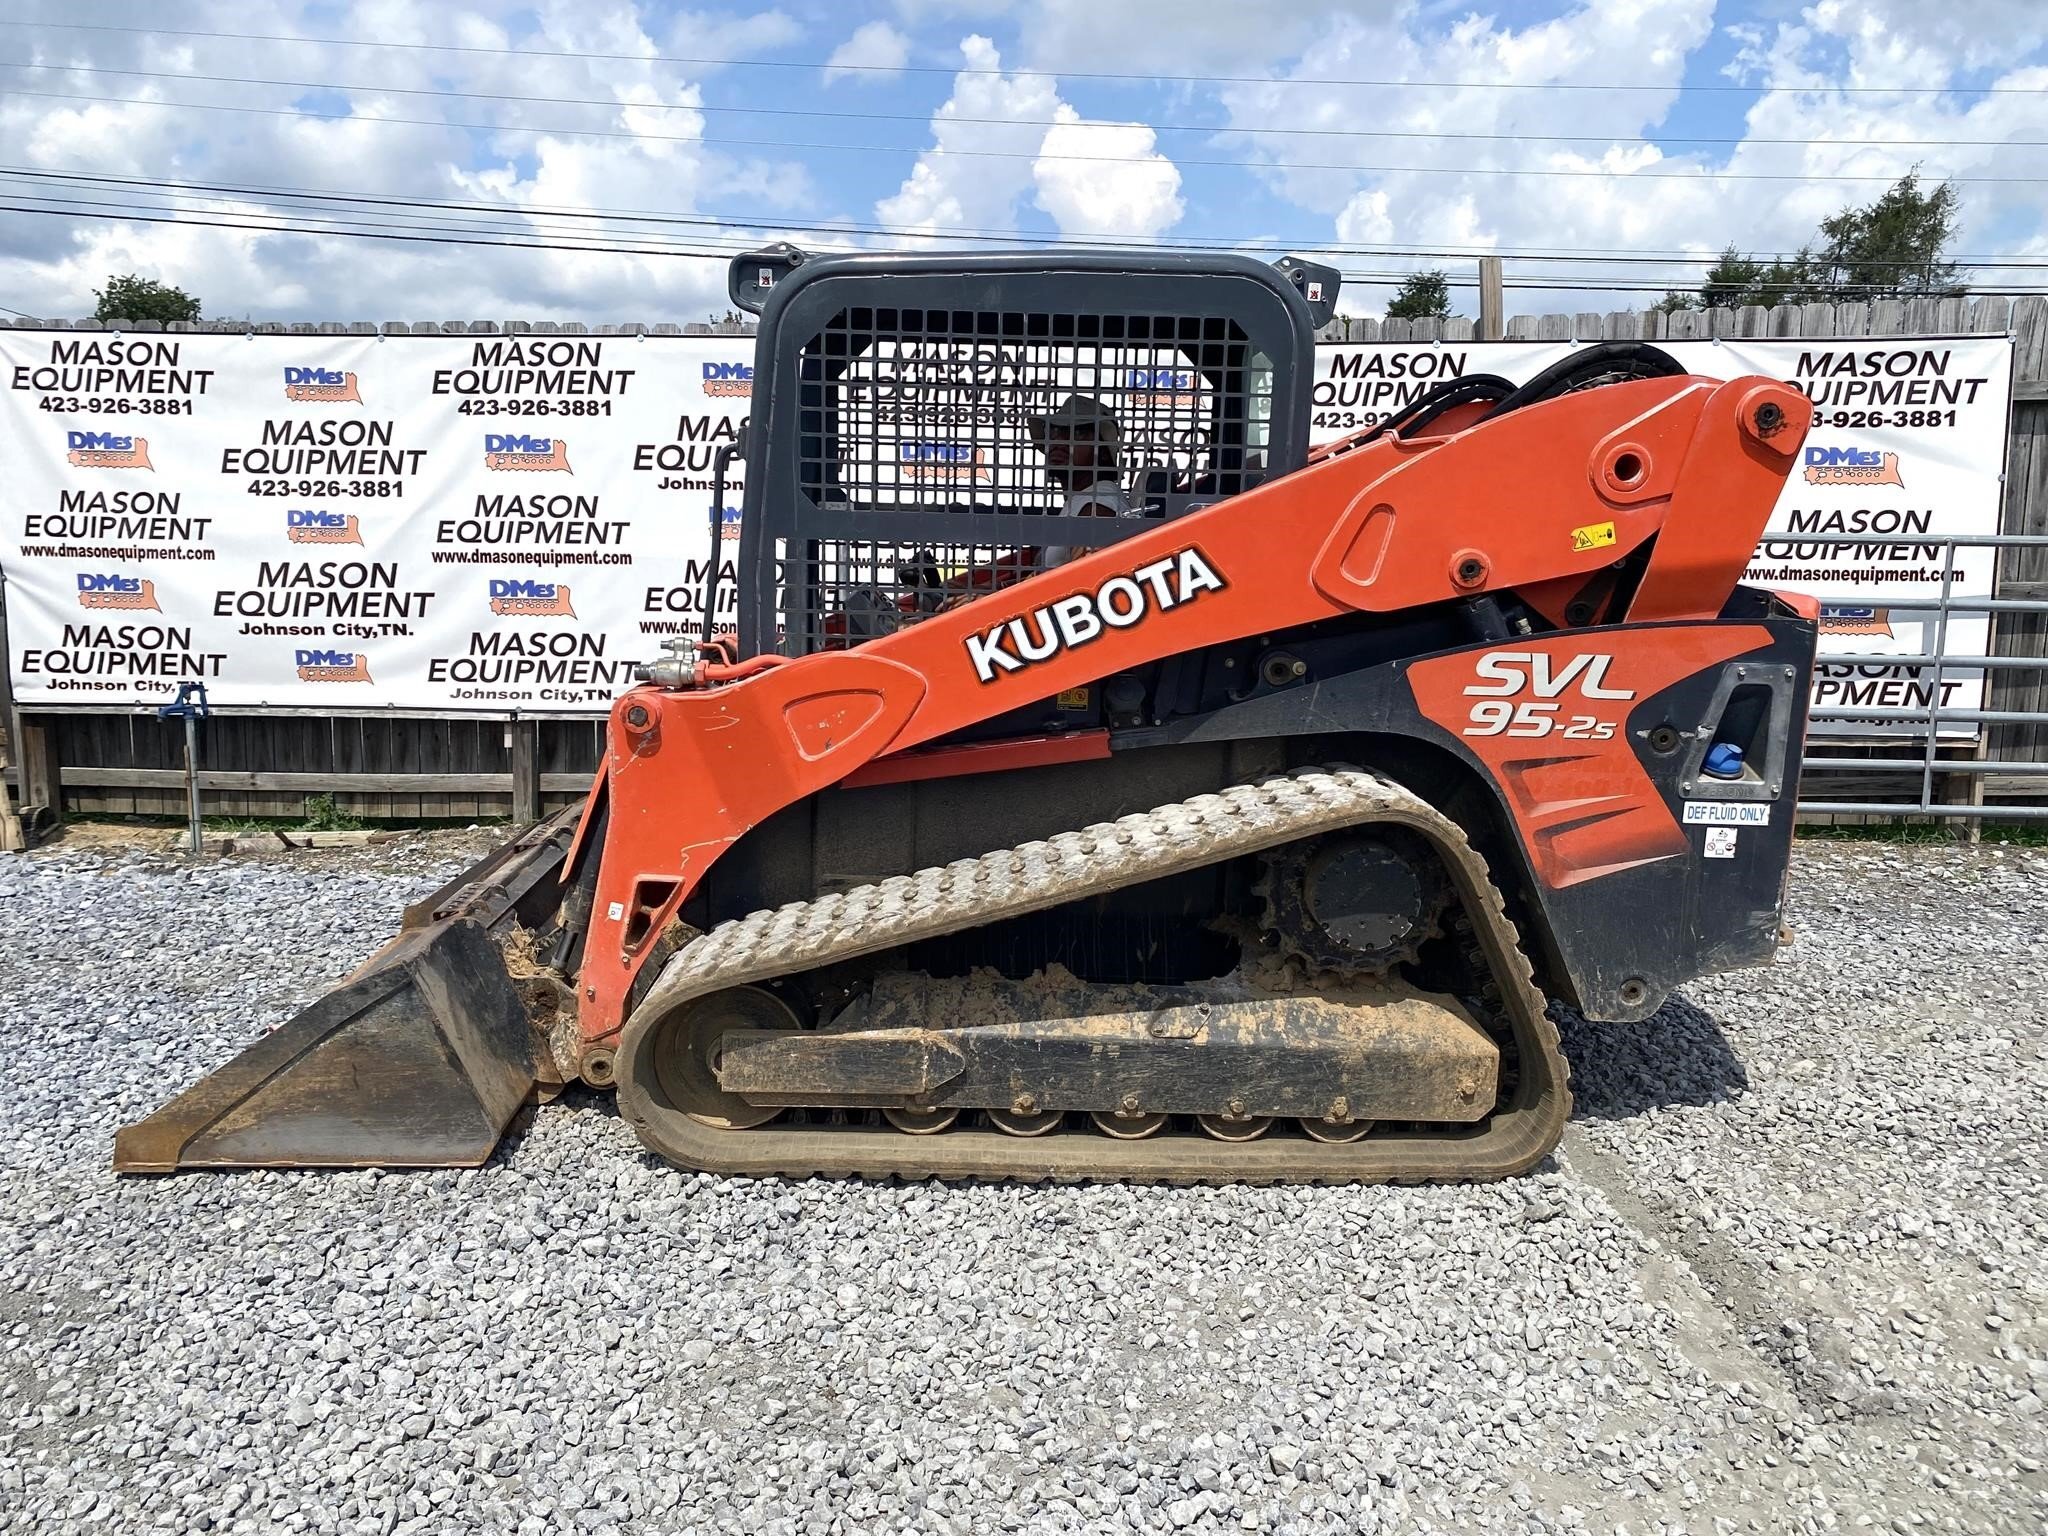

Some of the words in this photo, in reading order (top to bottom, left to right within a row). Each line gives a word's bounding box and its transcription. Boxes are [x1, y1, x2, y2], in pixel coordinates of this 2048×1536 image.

[52, 341, 179, 366] MASON
[473, 342, 601, 367] MASON
[1330, 353, 1467, 378] MASON
[1796, 351, 1951, 377] MASON
[12, 366, 214, 394] EQUIPMENT
[432, 370, 635, 394] EQUIPMENT
[40, 397, 191, 415] 423-926-3881
[458, 400, 610, 416] 423-926-3881
[262, 421, 393, 446] MASON
[222, 449, 427, 475] EQUIPMENT
[248, 480, 402, 497] 423-926-3881
[60, 490, 180, 514] MASON
[475, 495, 598, 518] MASON
[25, 515, 211, 540] EQUIPMENT
[437, 521, 630, 544] EQUIPMENT
[1787, 510, 1932, 533] MASON
[21, 543, 215, 562] www.dmasonequipment.com
[432, 549, 632, 567] www.dmasonequipment.com
[258, 562, 397, 588] MASON
[214, 591, 435, 617] EQUIPMENT
[965, 548, 1224, 683] KUBOTA
[62, 625, 190, 650] MASON
[239, 623, 325, 635] Johnson
[335, 623, 414, 639] City,TN.
[470, 633, 606, 656] MASON
[22, 650, 227, 676] EQUIPMENT
[427, 659, 640, 684] EQUIPMENT
[46, 679, 127, 690] Johnson
[1463, 651, 1637, 700] SVL
[451, 689, 531, 699] Johnson
[539, 688, 618, 704] City,TN.
[1687, 806, 1706, 819] DEF
[1709, 806, 1737, 821] FLUID
[1739, 807, 1766, 821] ONLY
